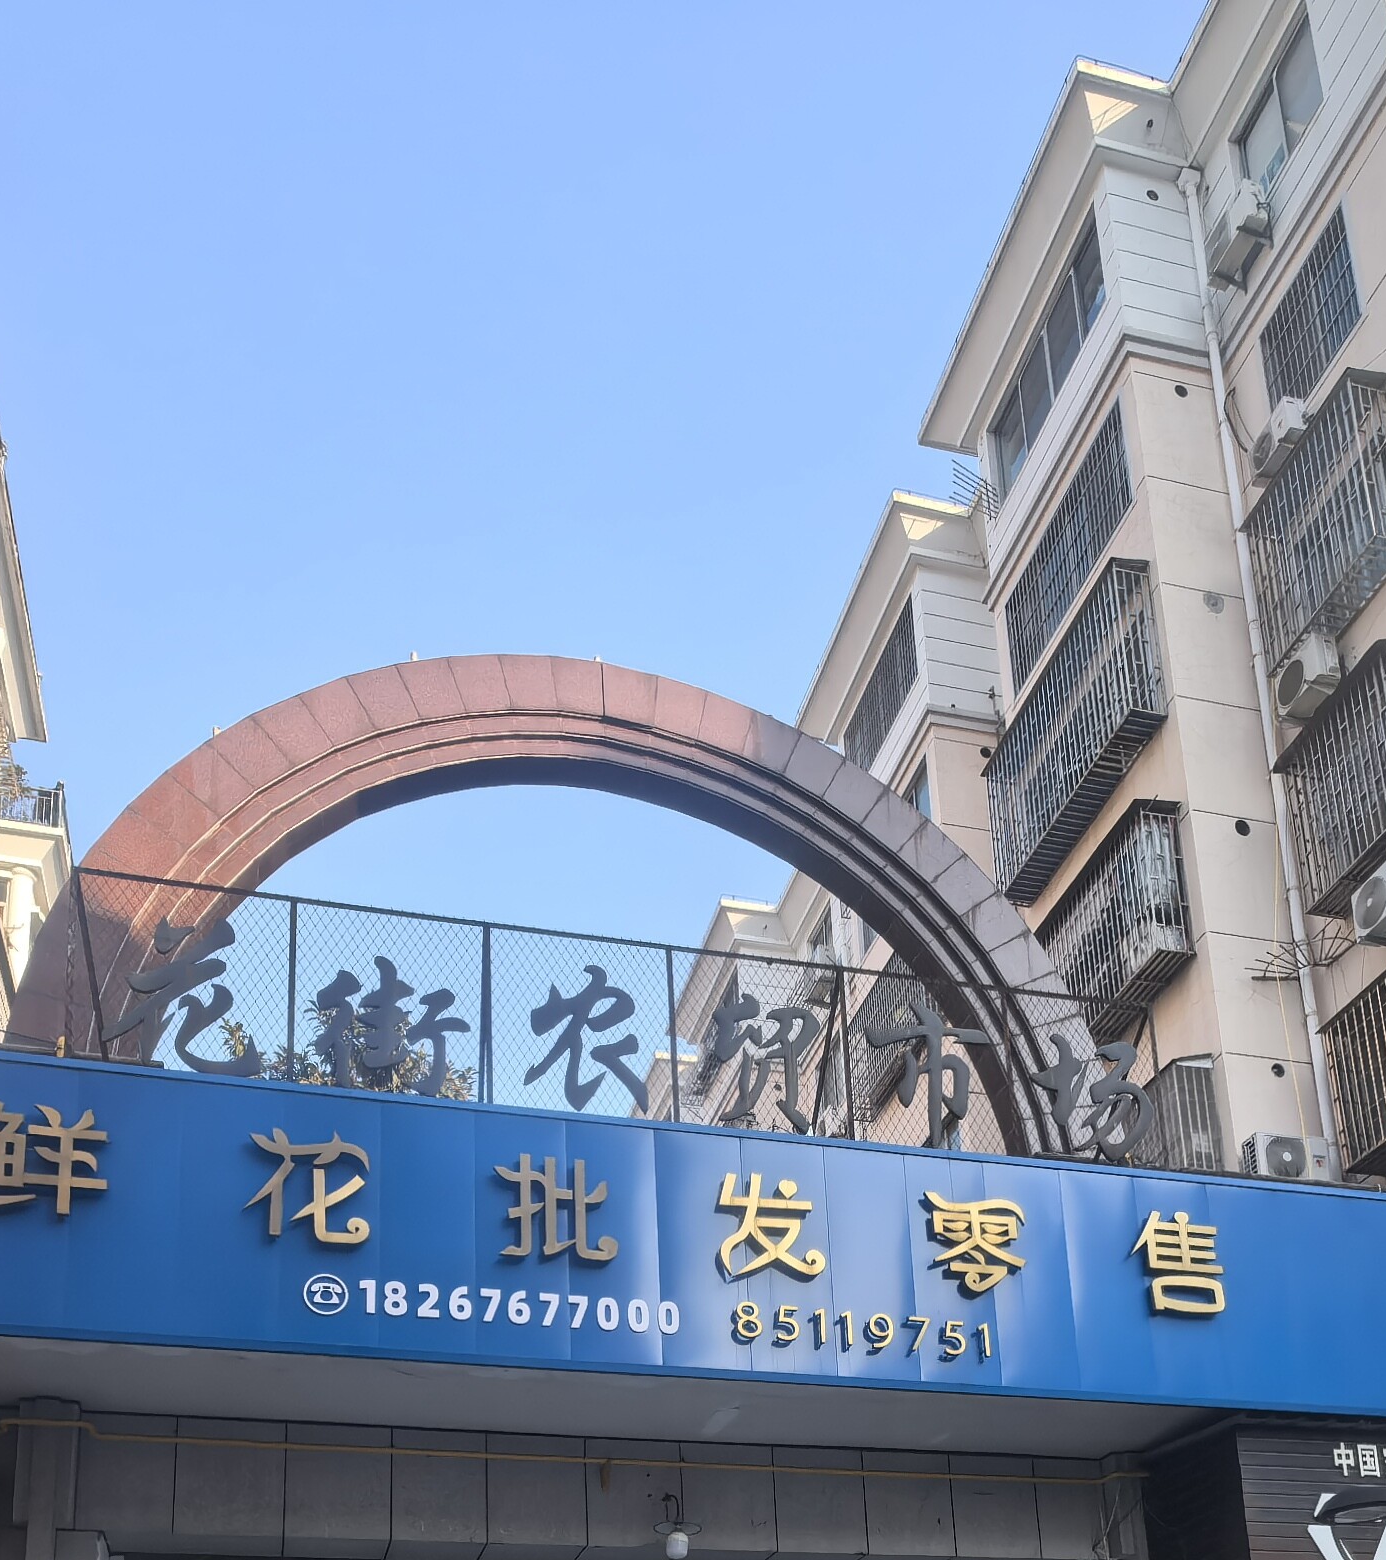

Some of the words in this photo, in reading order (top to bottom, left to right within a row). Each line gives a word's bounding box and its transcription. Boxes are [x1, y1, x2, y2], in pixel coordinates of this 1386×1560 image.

[106, 918, 1155, 1163] 花街农贸市场
[357, 1277, 681, 1337] 18267677000
[732, 1300, 995, 1360] 85119751
